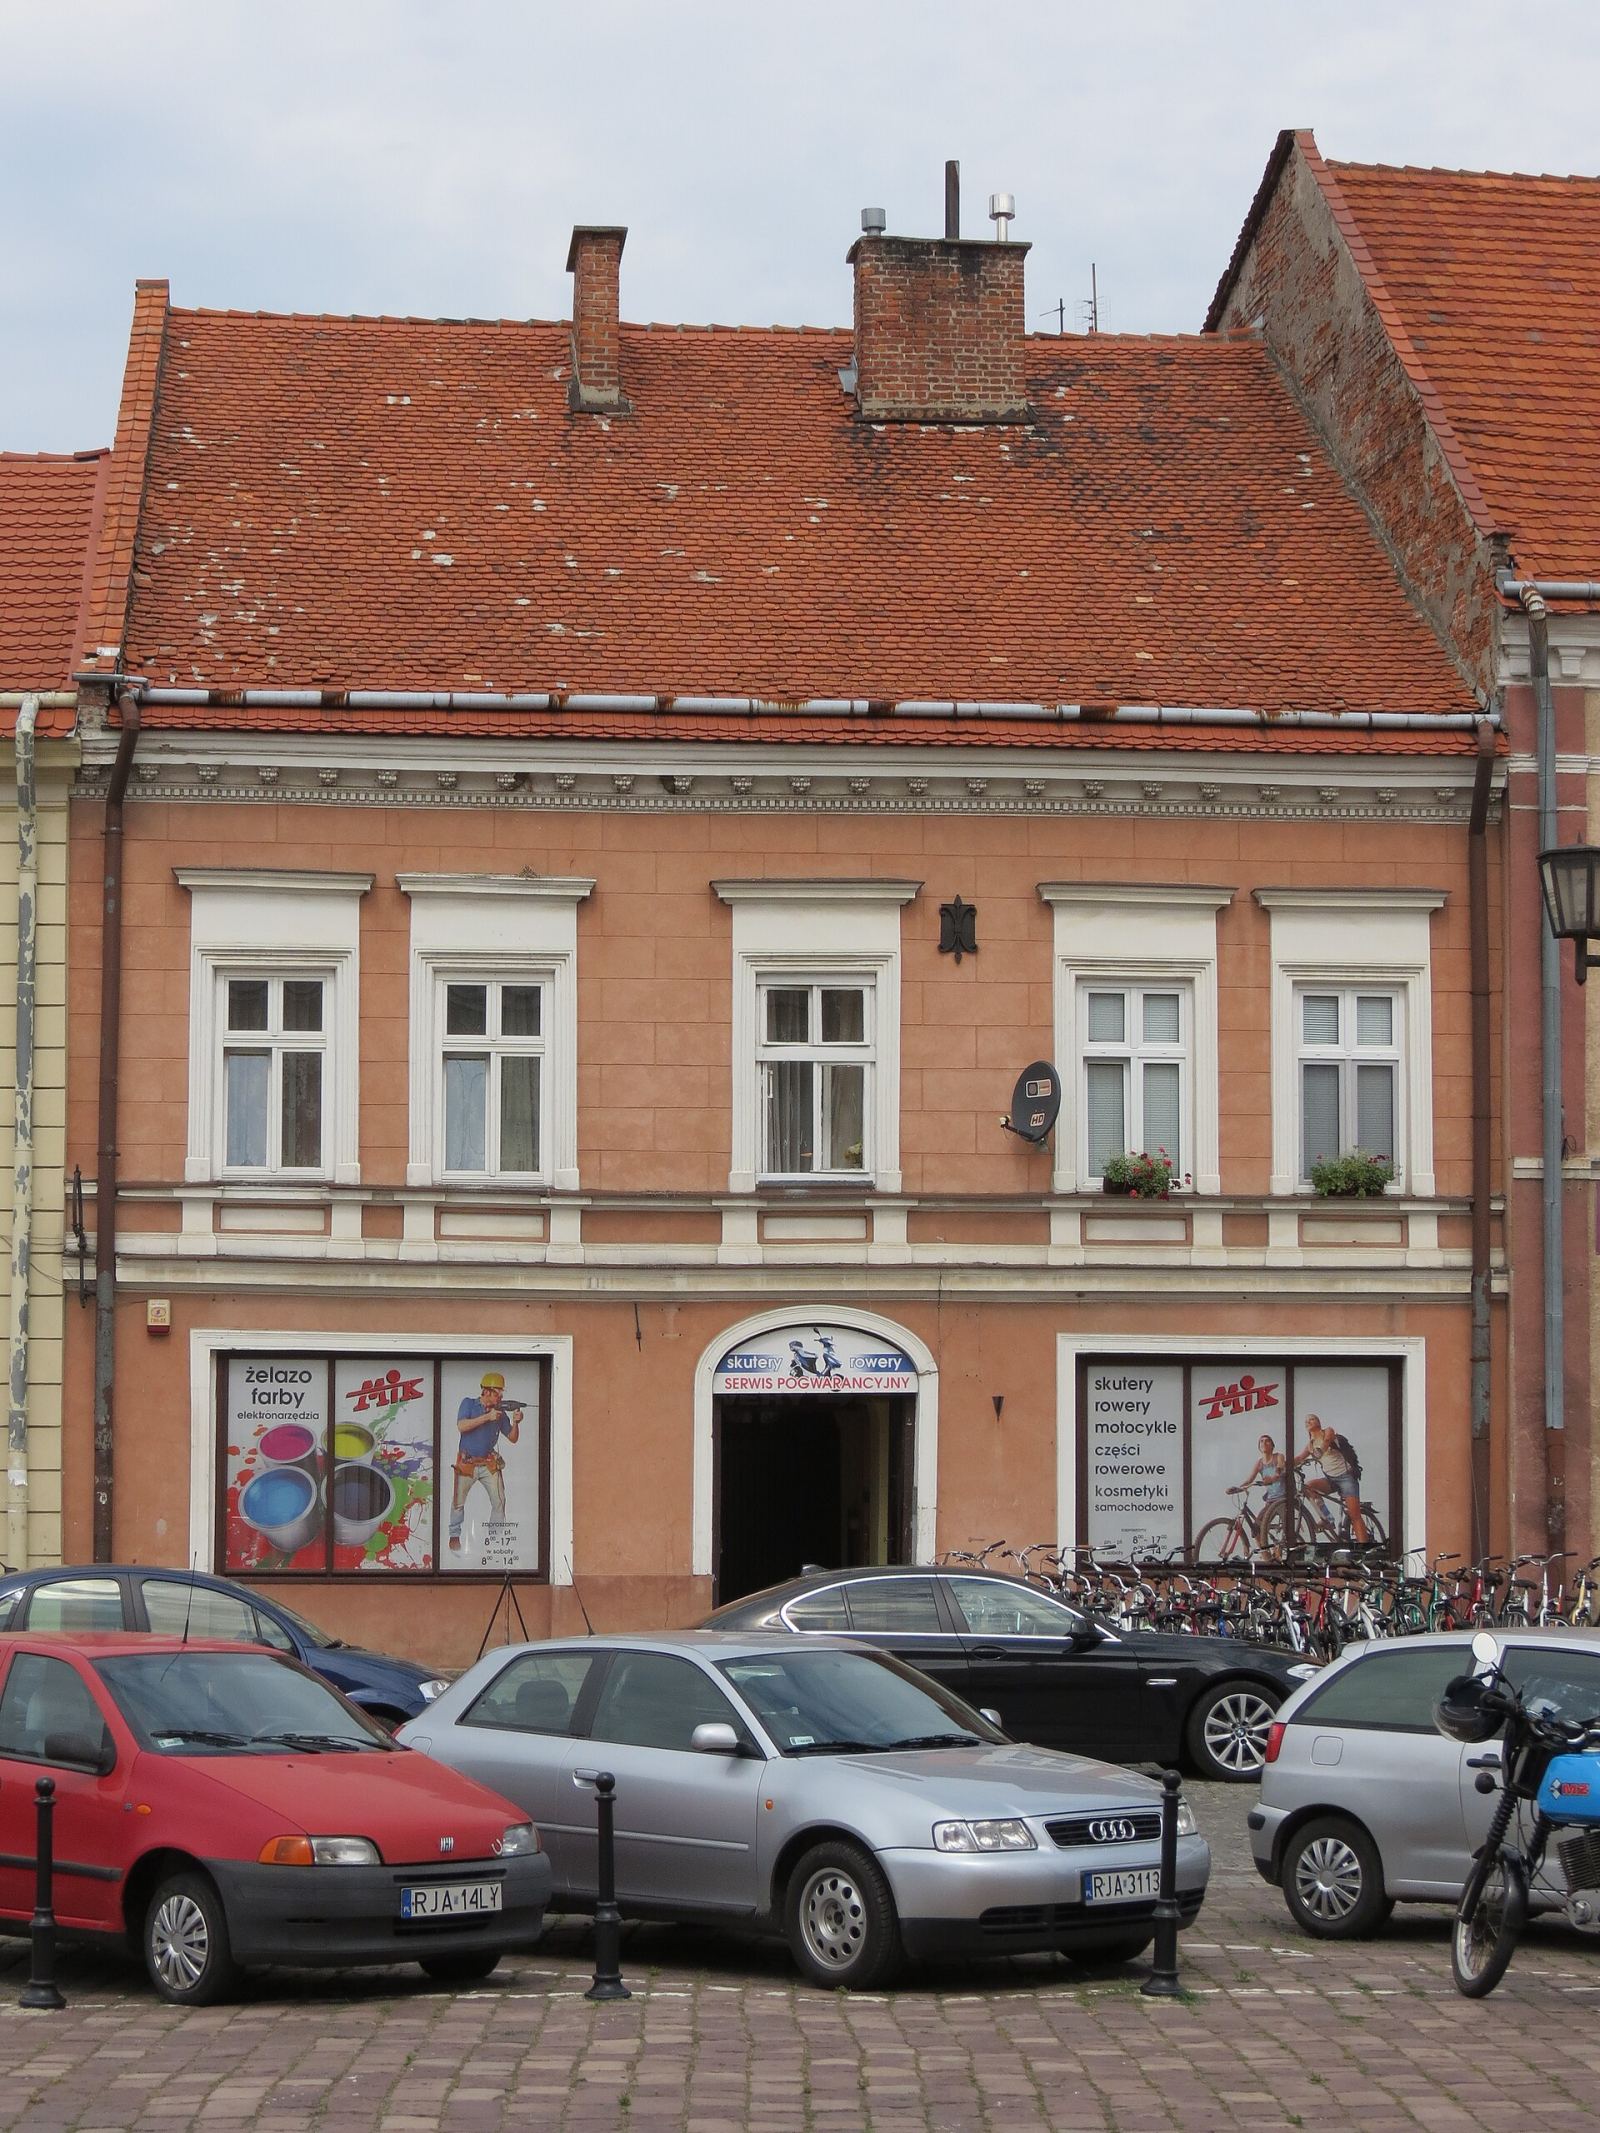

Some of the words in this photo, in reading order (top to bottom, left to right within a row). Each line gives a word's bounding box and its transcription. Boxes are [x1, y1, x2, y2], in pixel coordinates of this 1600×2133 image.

[727, 1355, 783, 1371] skutery
[850, 1356, 902, 1370] rowery
[245, 1366, 312, 1383] żelazo
[725, 1377, 773, 1390] SERWIS
[778, 1377, 910, 1390] POGWARANCYJNY
[1095, 1376, 1153, 1393] skutery
[251, 1387, 305, 1408] farby
[1095, 1401, 1150, 1415] rowery
[237, 1411, 319, 1421] elektronarzędzia
[1095, 1421, 1177, 1436] motocykle
[1095, 1443, 1140, 1459] części
[1095, 1465, 1165, 1475] rowerowe
[1095, 1485, 1168, 1499] kosmetyki
[1095, 1502, 1174, 1512] samochodowe
[1094, 1874, 1123, 1898] RJA
[414, 1889, 453, 1914] RJA
[462, 1886, 499, 1909] 14LY
